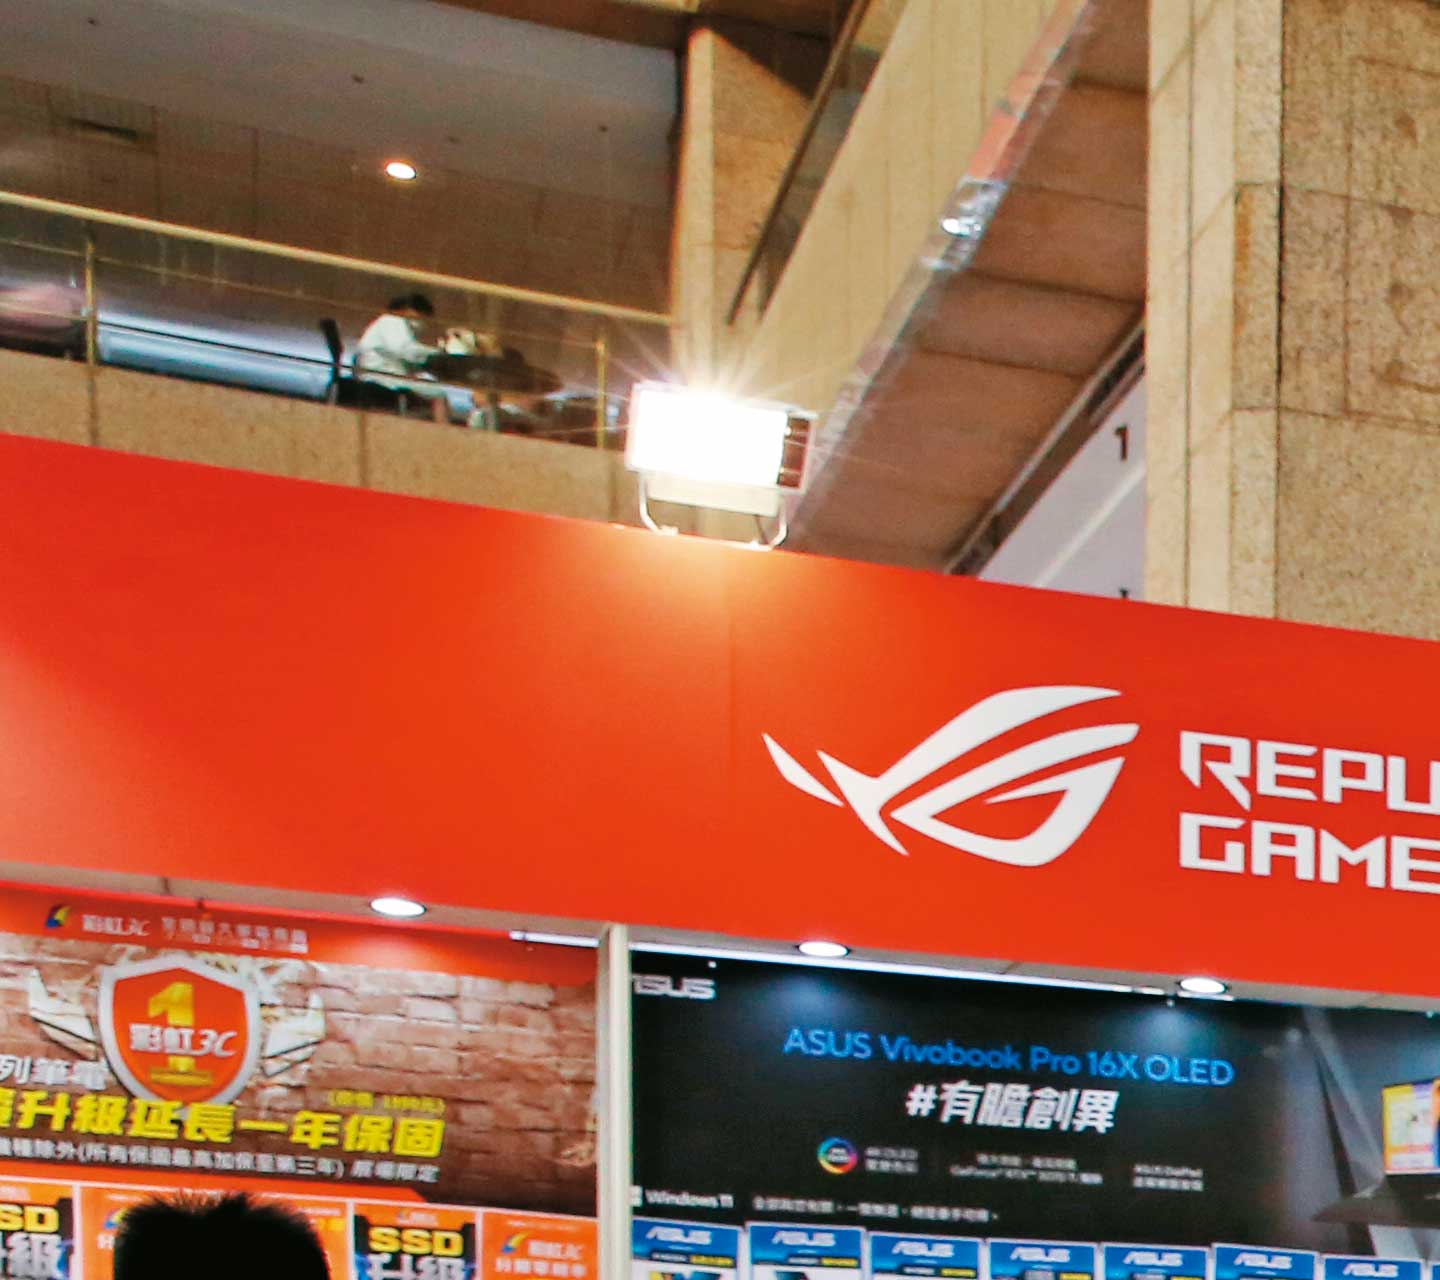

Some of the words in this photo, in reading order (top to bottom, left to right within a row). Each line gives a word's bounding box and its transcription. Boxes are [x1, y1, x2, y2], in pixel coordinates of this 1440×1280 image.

[783, 1027, 871, 1059] ASUS
[880, 1034, 1020, 1071] Vivobook
[1030, 1046, 1083, 1076] Pro
[1088, 1050, 1138, 1080] 16X
[1144, 1052, 1236, 1088] OLED
[0, 1087, 446, 1159] 升級延長一年保固
[369, 1227, 464, 1257] SSD
[1123, 1250, 1182, 1267] ASUS
[1234, 1253, 1292, 1270] ASUS
[1343, 1262, 1398, 1279] ASUS
